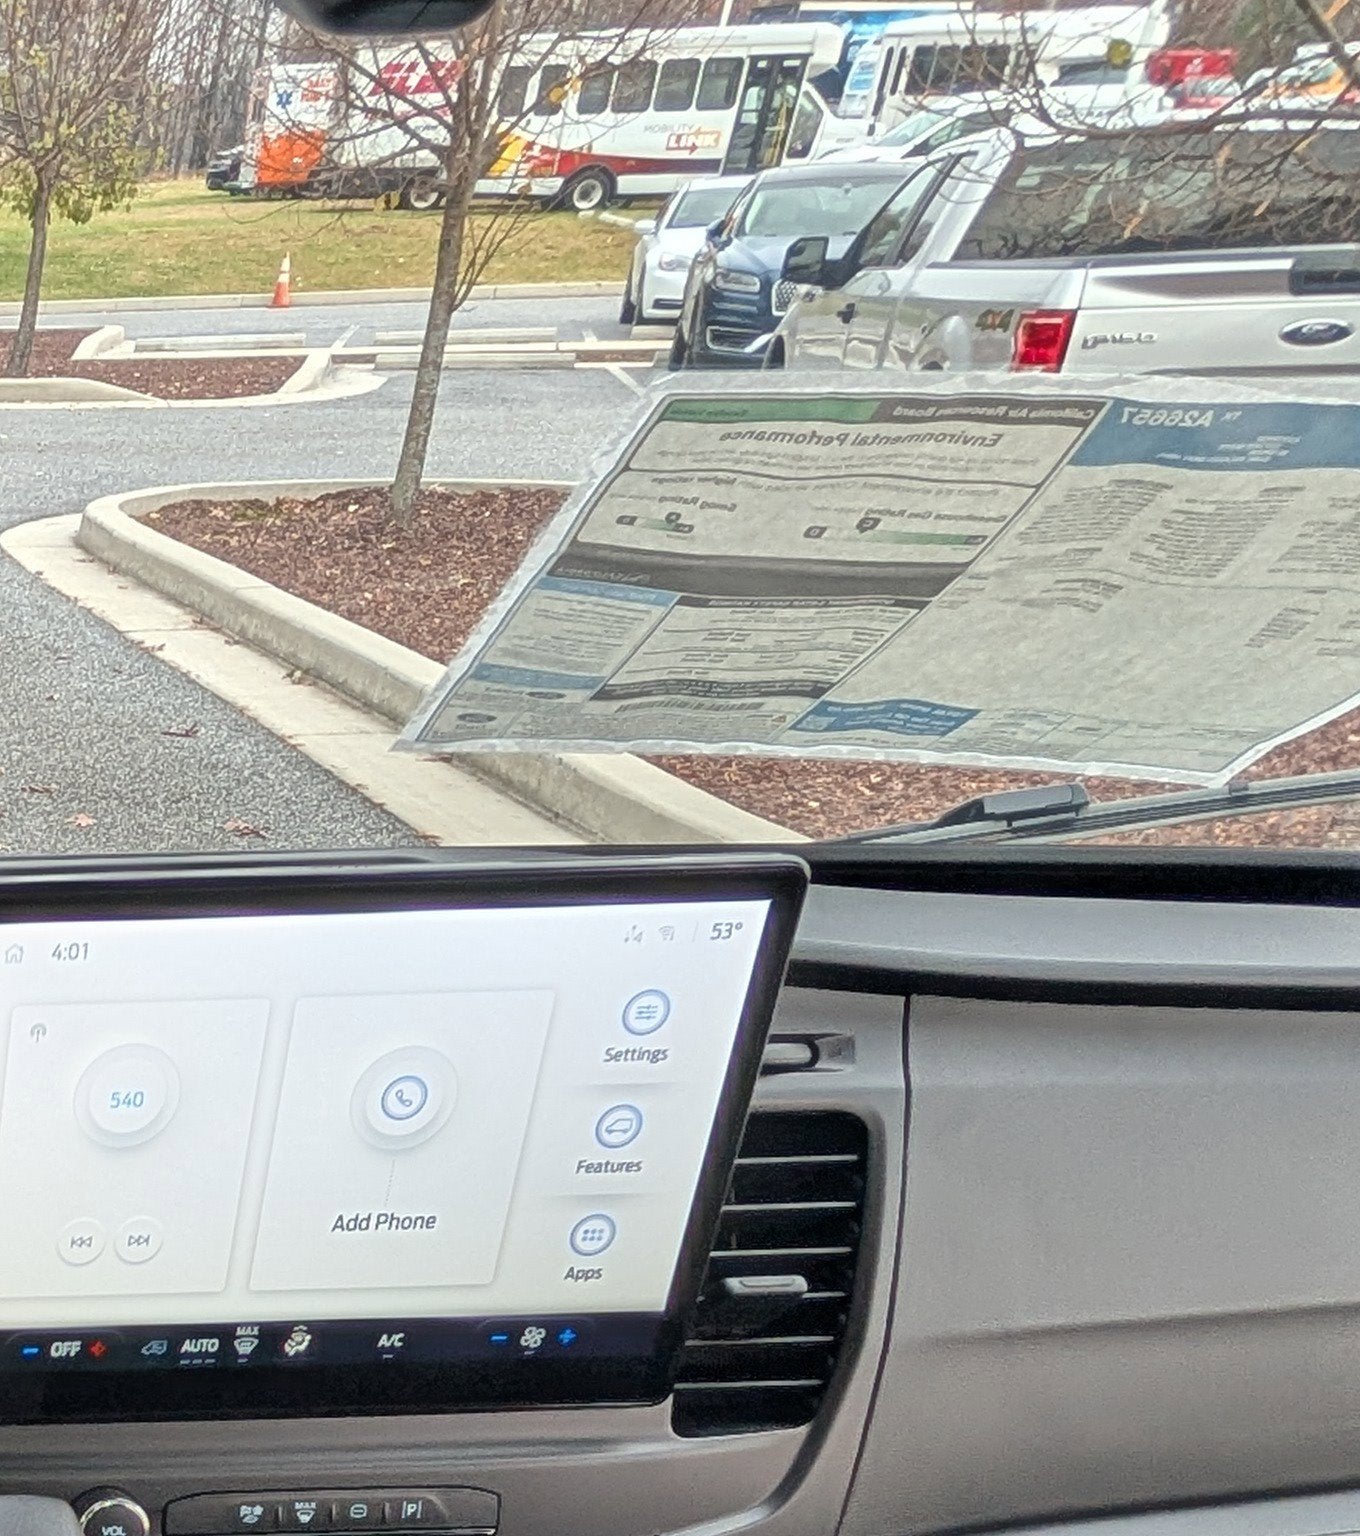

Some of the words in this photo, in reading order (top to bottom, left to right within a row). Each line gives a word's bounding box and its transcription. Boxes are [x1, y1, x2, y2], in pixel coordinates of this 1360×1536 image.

[644, 123, 695, 133] MOBILITY
[668, 133, 719, 148] LINK
[709, 921, 744, 941] 53°
[51, 942, 90, 962] 4:01
[602, 1045, 671, 1064] Settings
[110, 1090, 145, 1109] 540
[575, 1159, 644, 1175] Features
[331, 1213, 376, 1234] Add
[375, 1212, 437, 1231] Phone
[563, 1266, 603, 1283] Apps
[235, 1326, 260, 1336] MAX
[180, 1338, 220, 1354] AUTO
[377, 1332, 405, 1348] A/C
[49, 1340, 82, 1359] OFF
[101, 1525, 127, 1536] VOL
